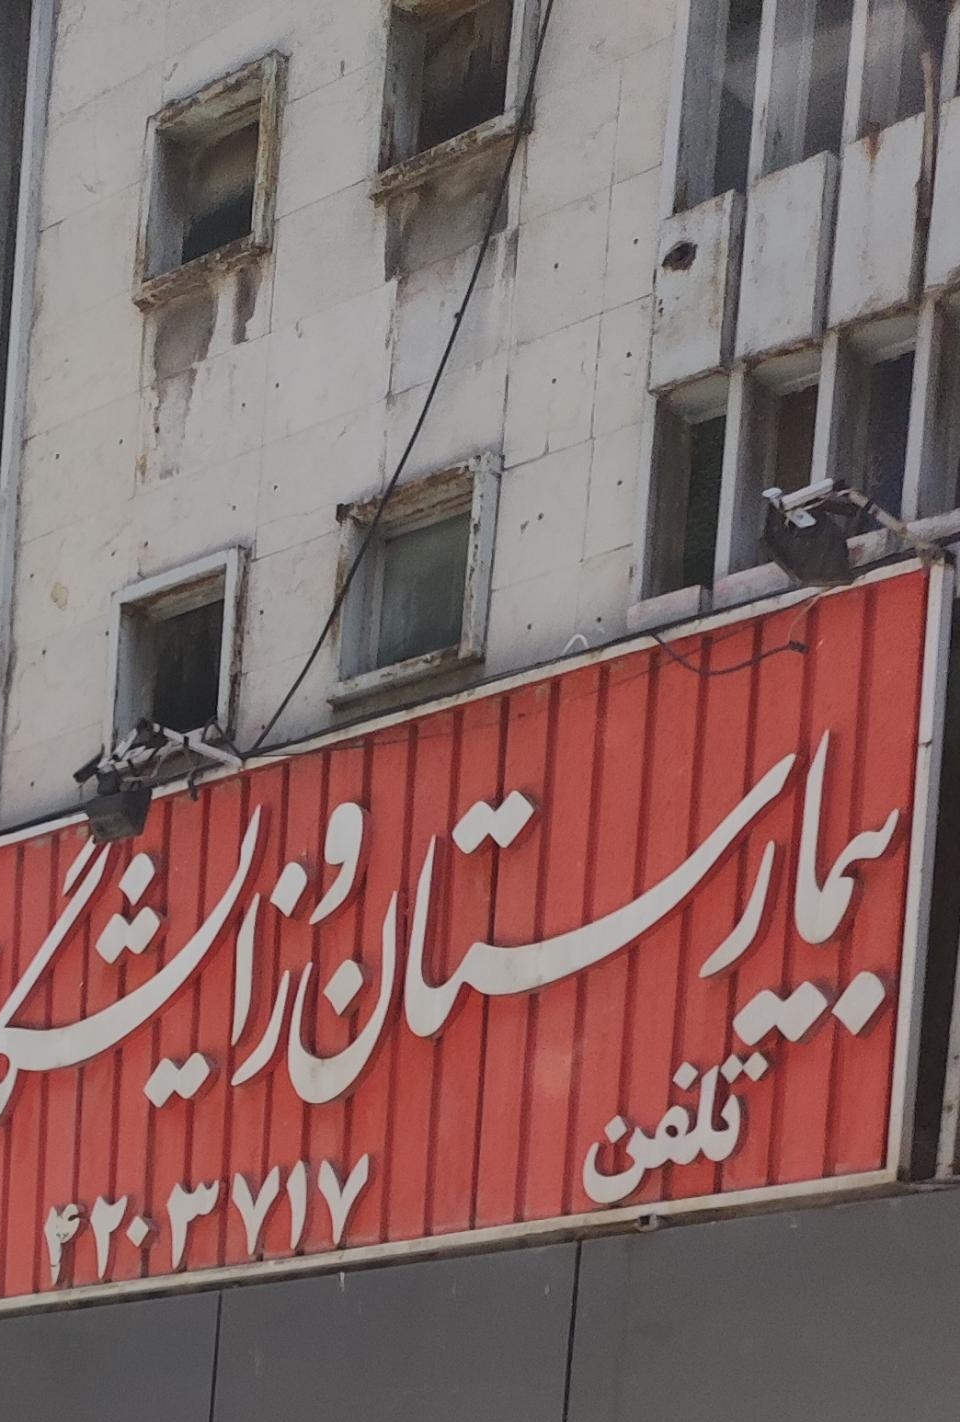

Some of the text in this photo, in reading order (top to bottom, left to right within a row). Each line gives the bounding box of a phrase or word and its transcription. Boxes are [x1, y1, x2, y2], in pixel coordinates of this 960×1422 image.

[288, 731, 899, 1104] بیمارستان
[310, 802, 363, 924] و
[583, 1051, 768, 1204] تلفن
